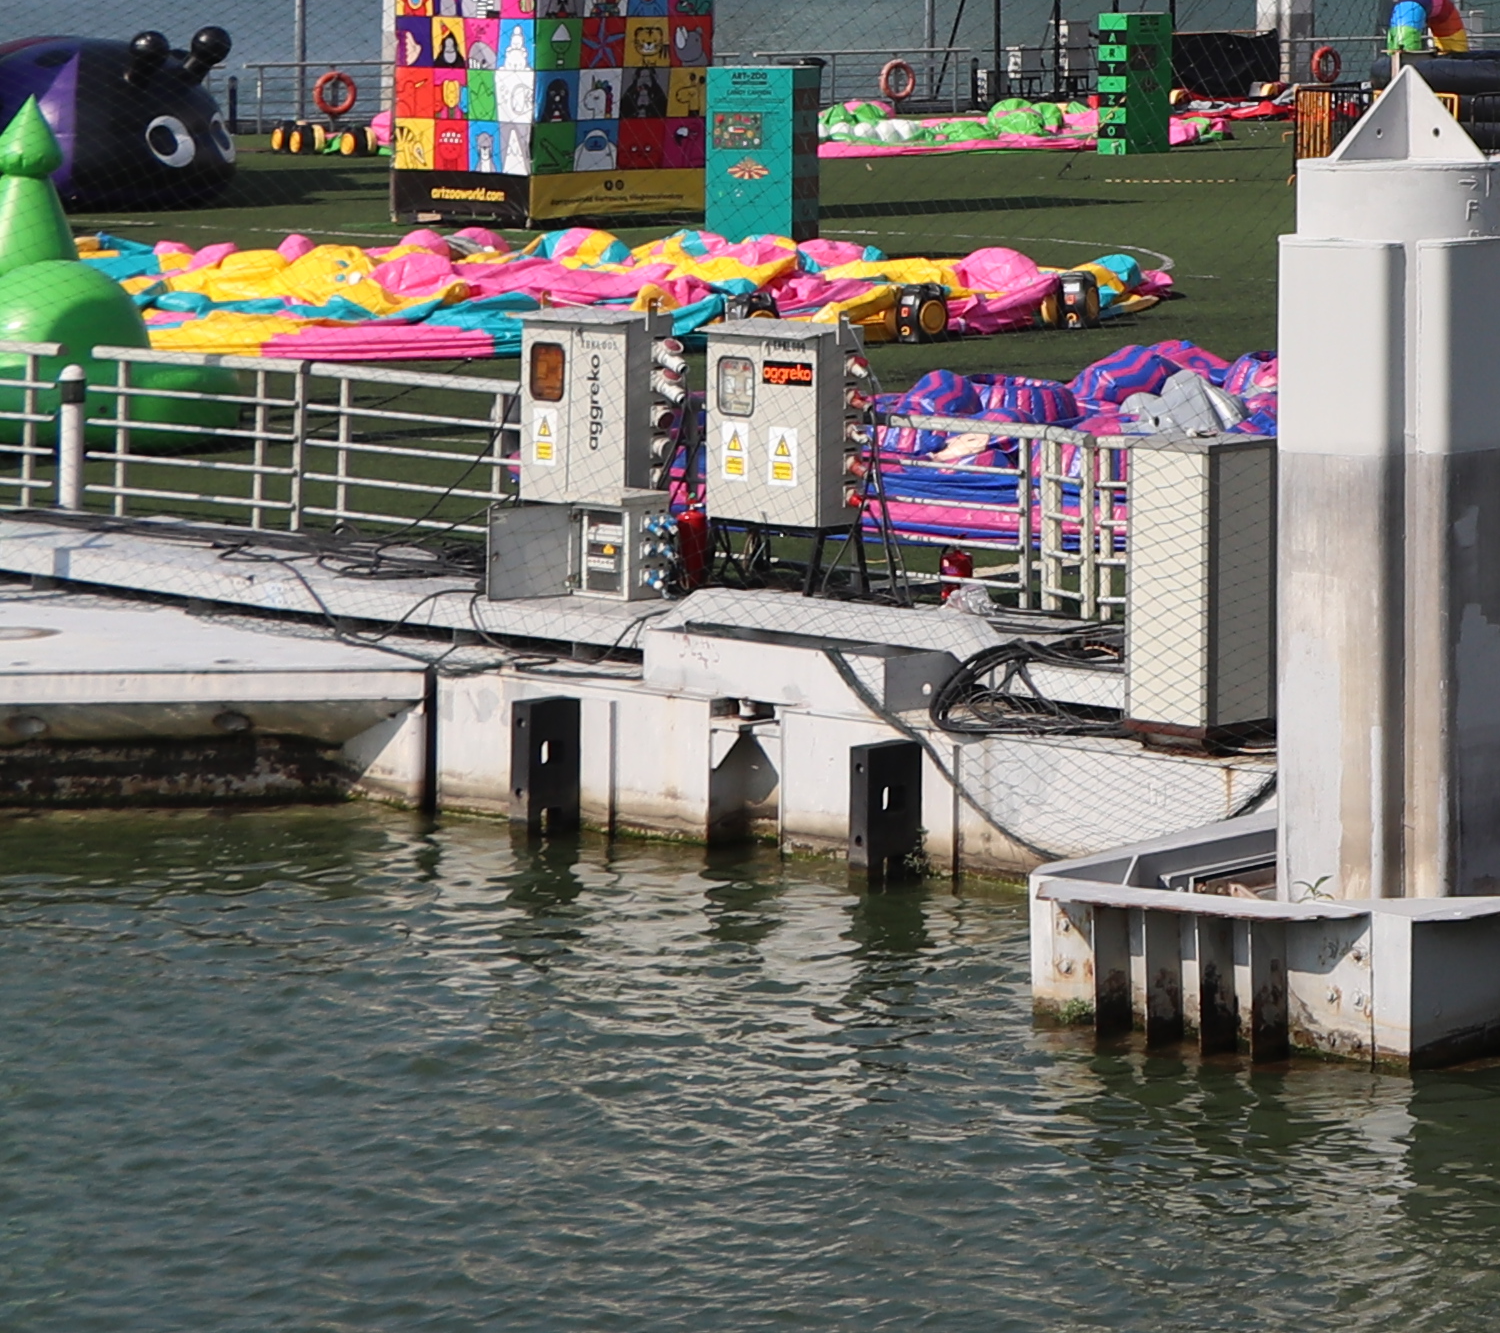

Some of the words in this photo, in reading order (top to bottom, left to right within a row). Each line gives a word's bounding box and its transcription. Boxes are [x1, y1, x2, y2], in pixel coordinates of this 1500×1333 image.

[732, 72, 768, 81] ART-ZOO
[763, 364, 812, 384] aggreko
[588, 354, 604, 451] aggreko
